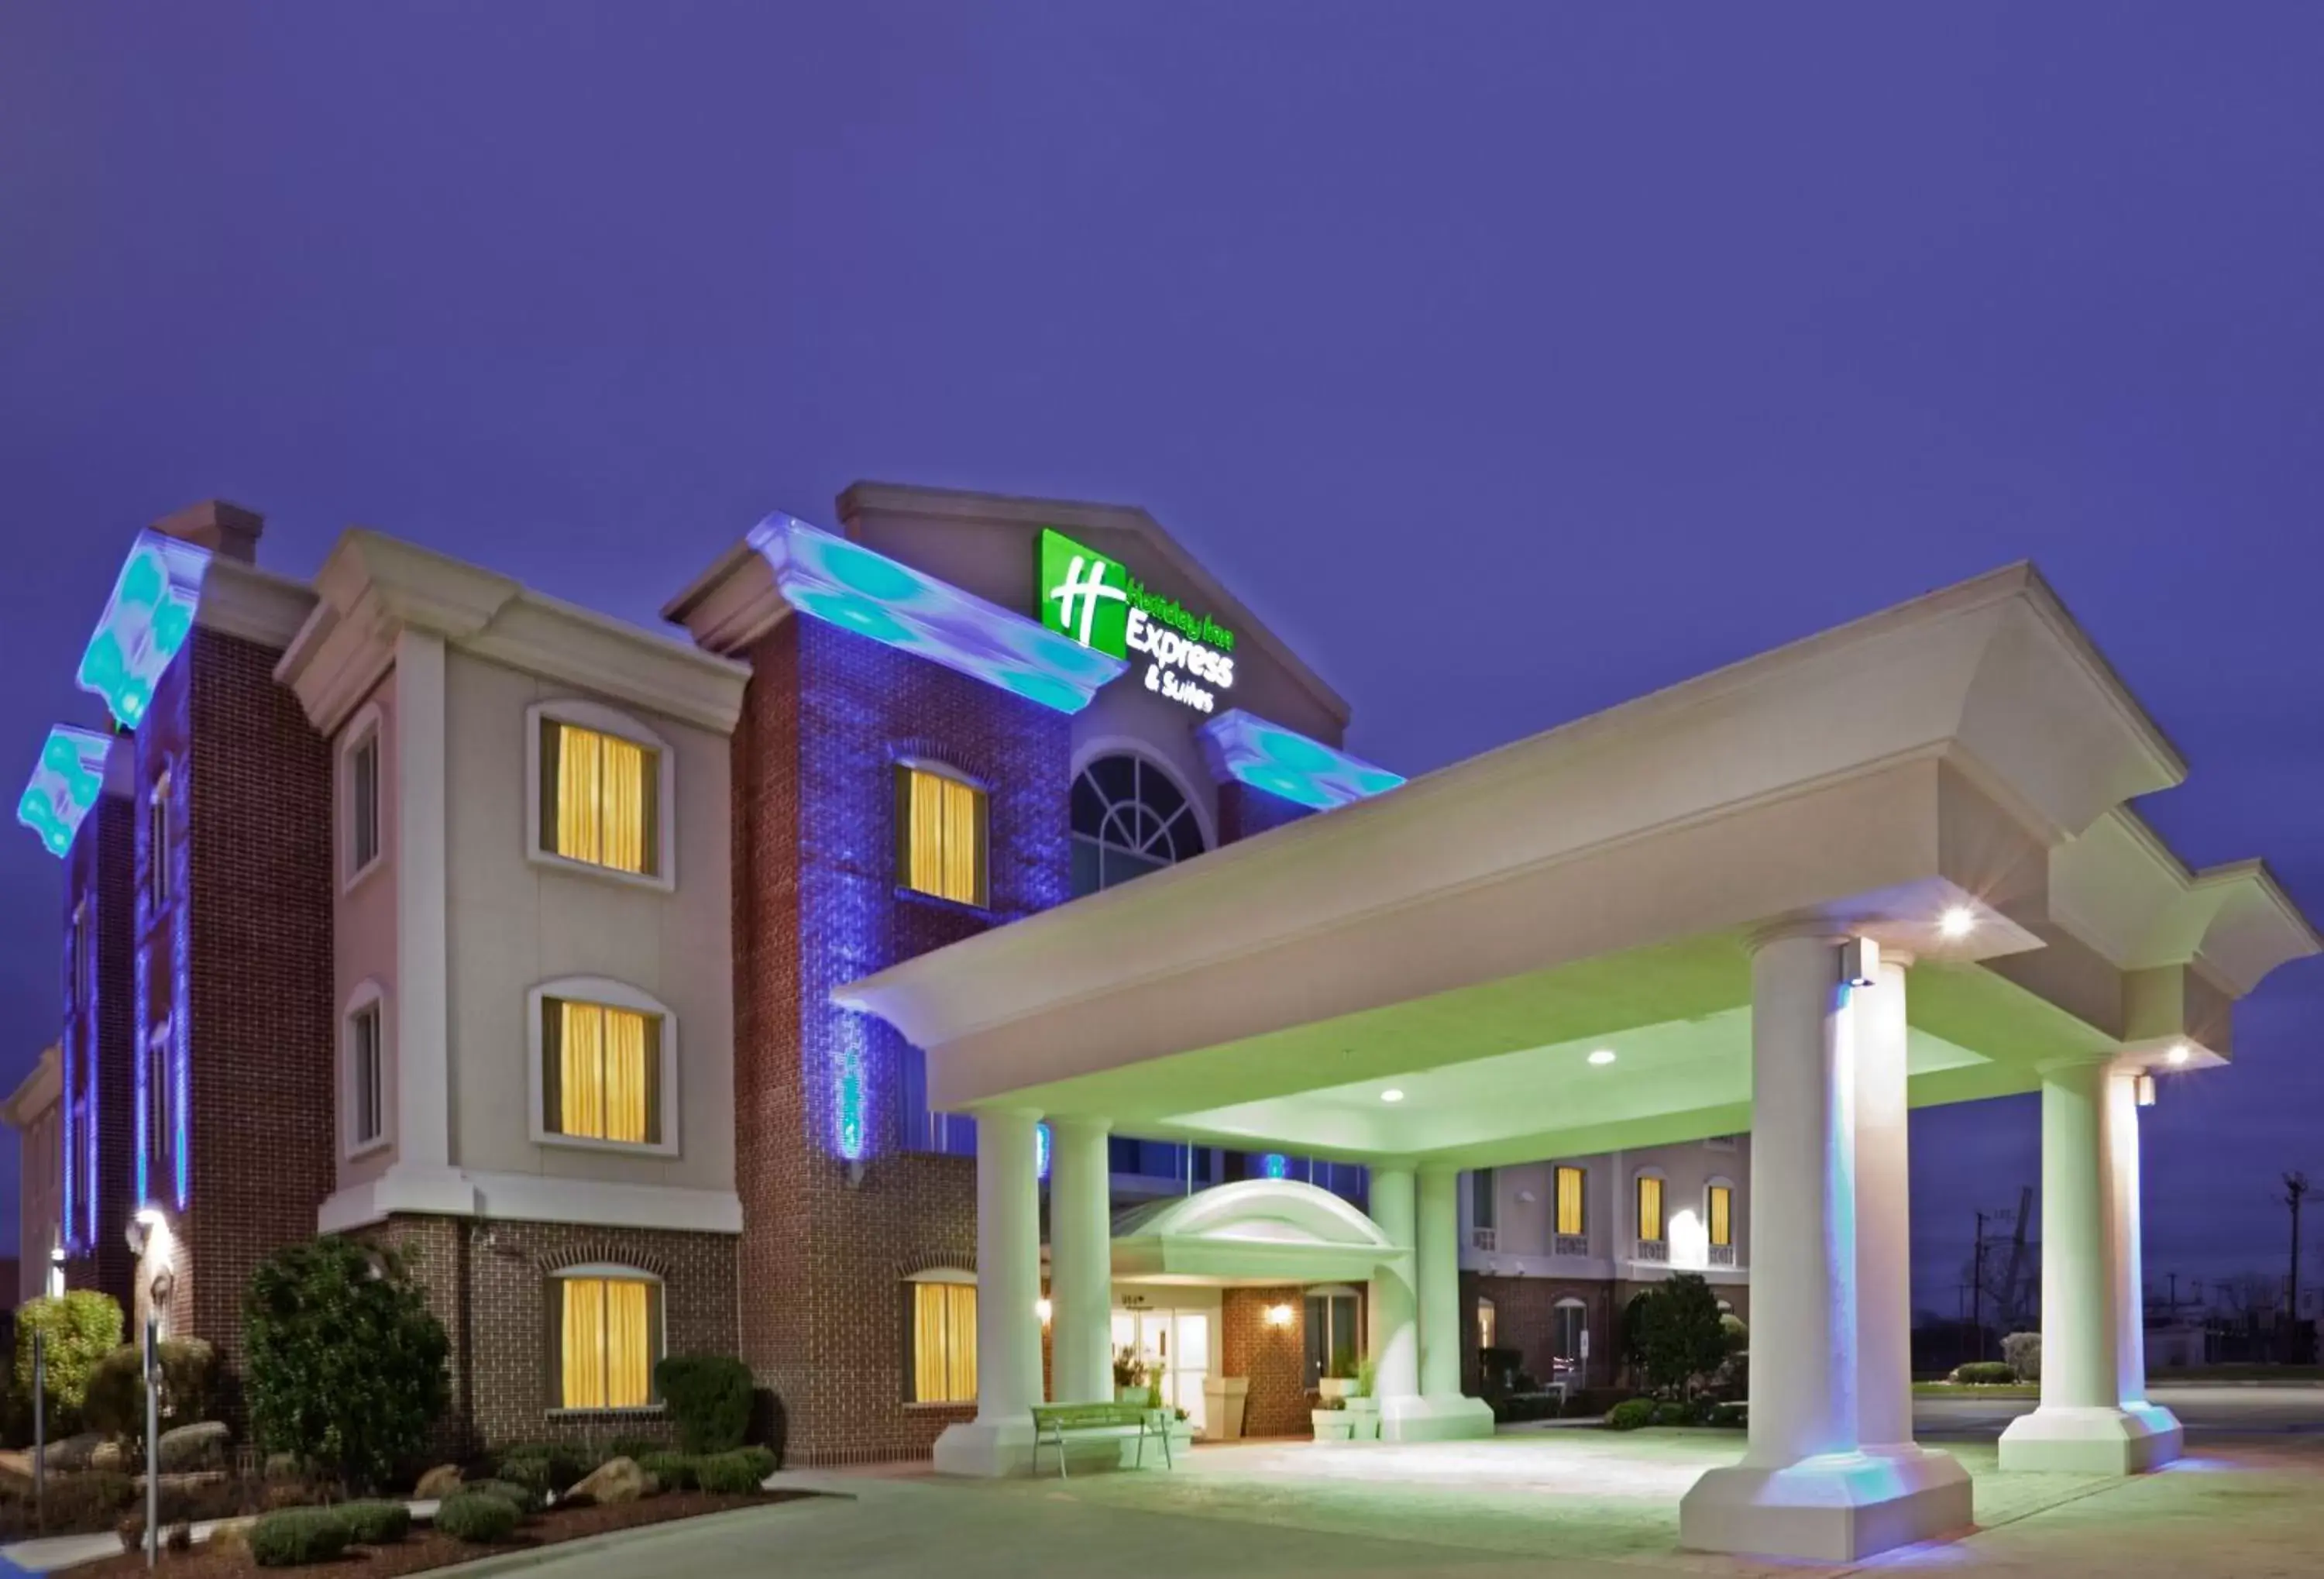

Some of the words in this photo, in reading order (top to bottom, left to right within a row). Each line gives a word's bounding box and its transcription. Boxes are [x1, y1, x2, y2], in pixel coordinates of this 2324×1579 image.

[1050, 556, 1126, 647] H
[1126, 577, 1202, 641] Holiday
[1202, 614, 1234, 652] Inn
[1126, 607, 1233, 688] Express
[1144, 664, 1160, 692] &
[1162, 671, 1214, 713] Suites
